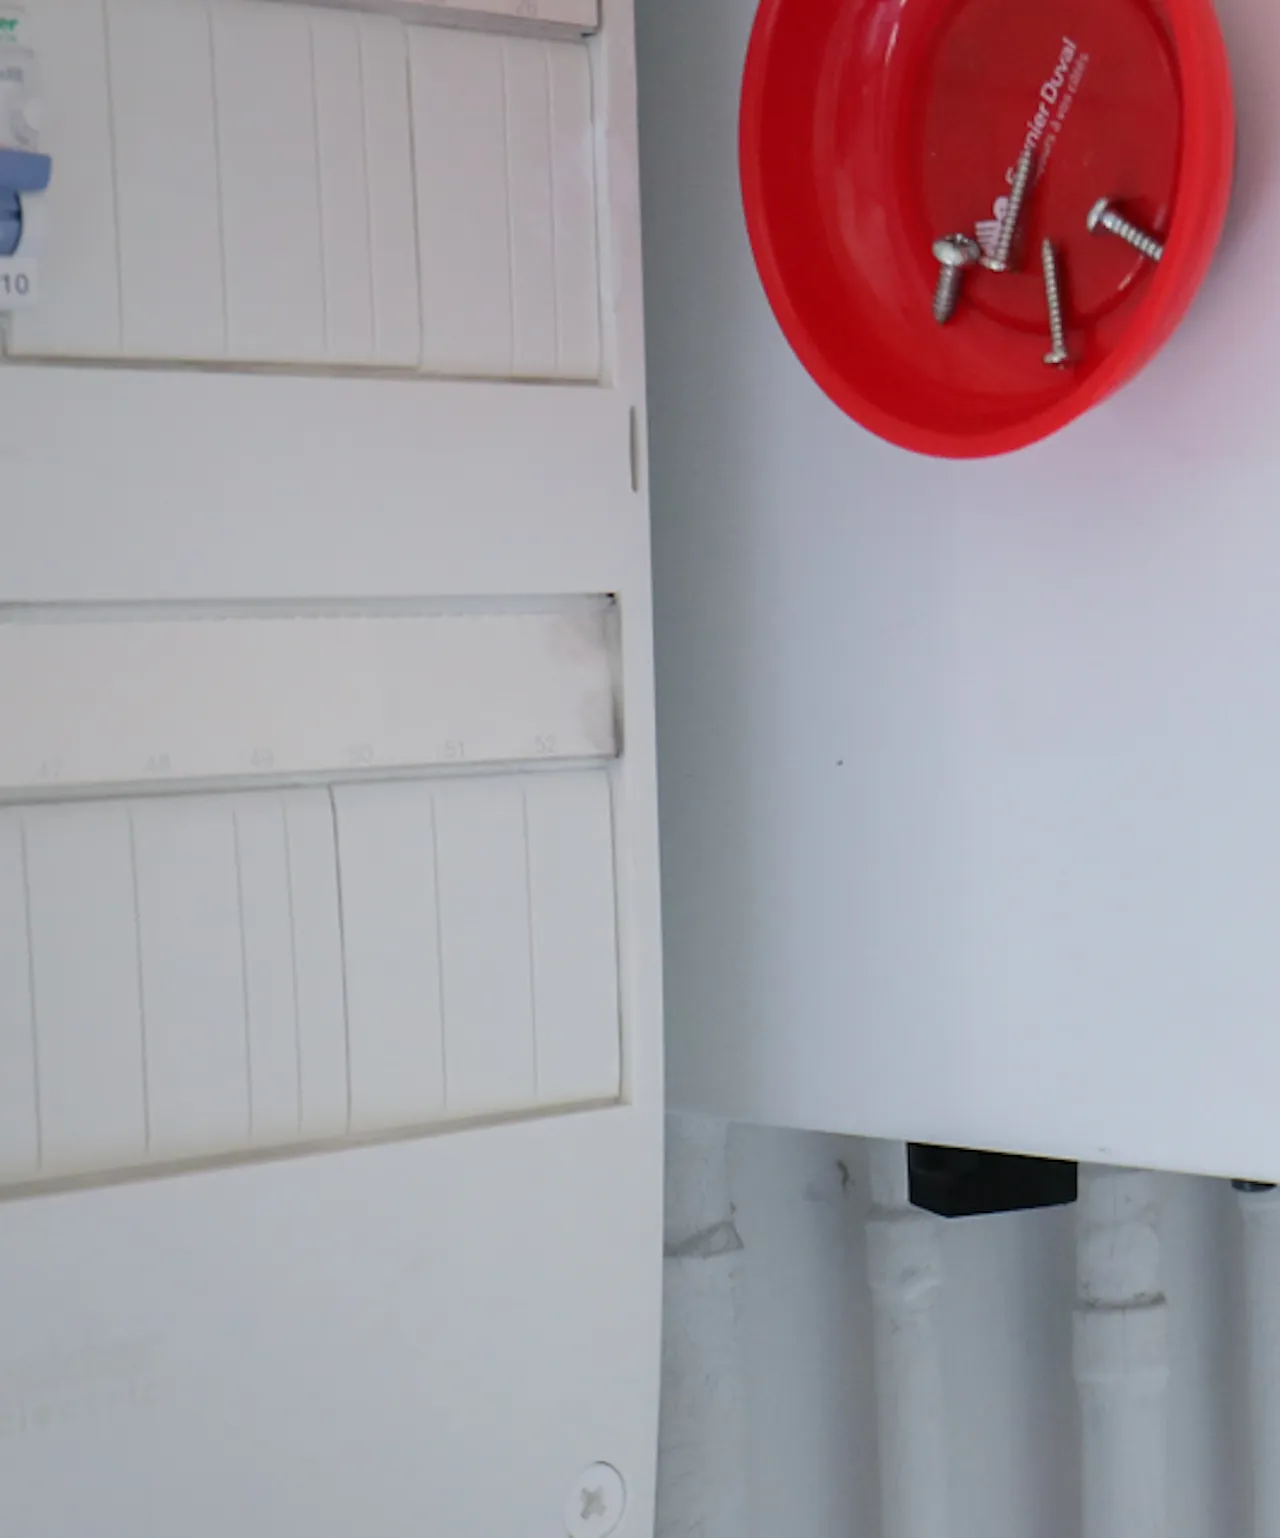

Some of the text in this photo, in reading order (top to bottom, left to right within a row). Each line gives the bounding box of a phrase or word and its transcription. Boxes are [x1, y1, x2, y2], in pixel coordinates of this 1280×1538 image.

[1040, 35, 1077, 104] Duval
[444, 739, 465, 759] 51
[534, 733, 557, 754] 52
